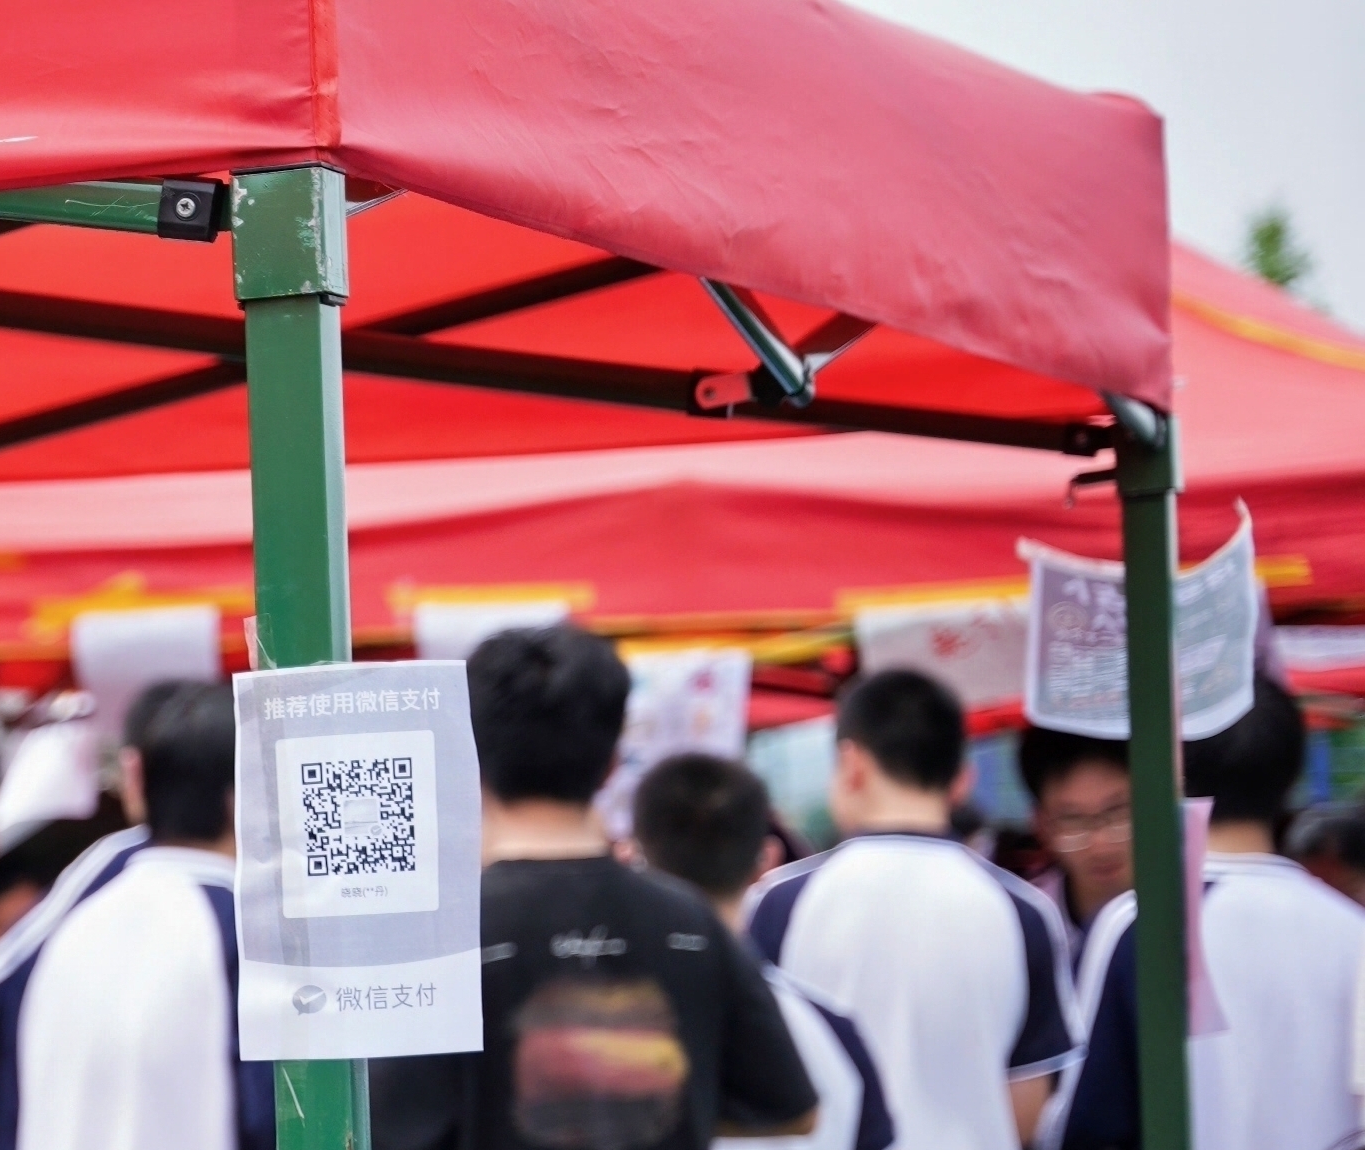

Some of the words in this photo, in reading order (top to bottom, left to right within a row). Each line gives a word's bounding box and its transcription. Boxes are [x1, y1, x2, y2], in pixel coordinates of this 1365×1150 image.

[264, 687, 441, 720] 推荐使用微信支付
[335, 982, 437, 1012] 微信支付
